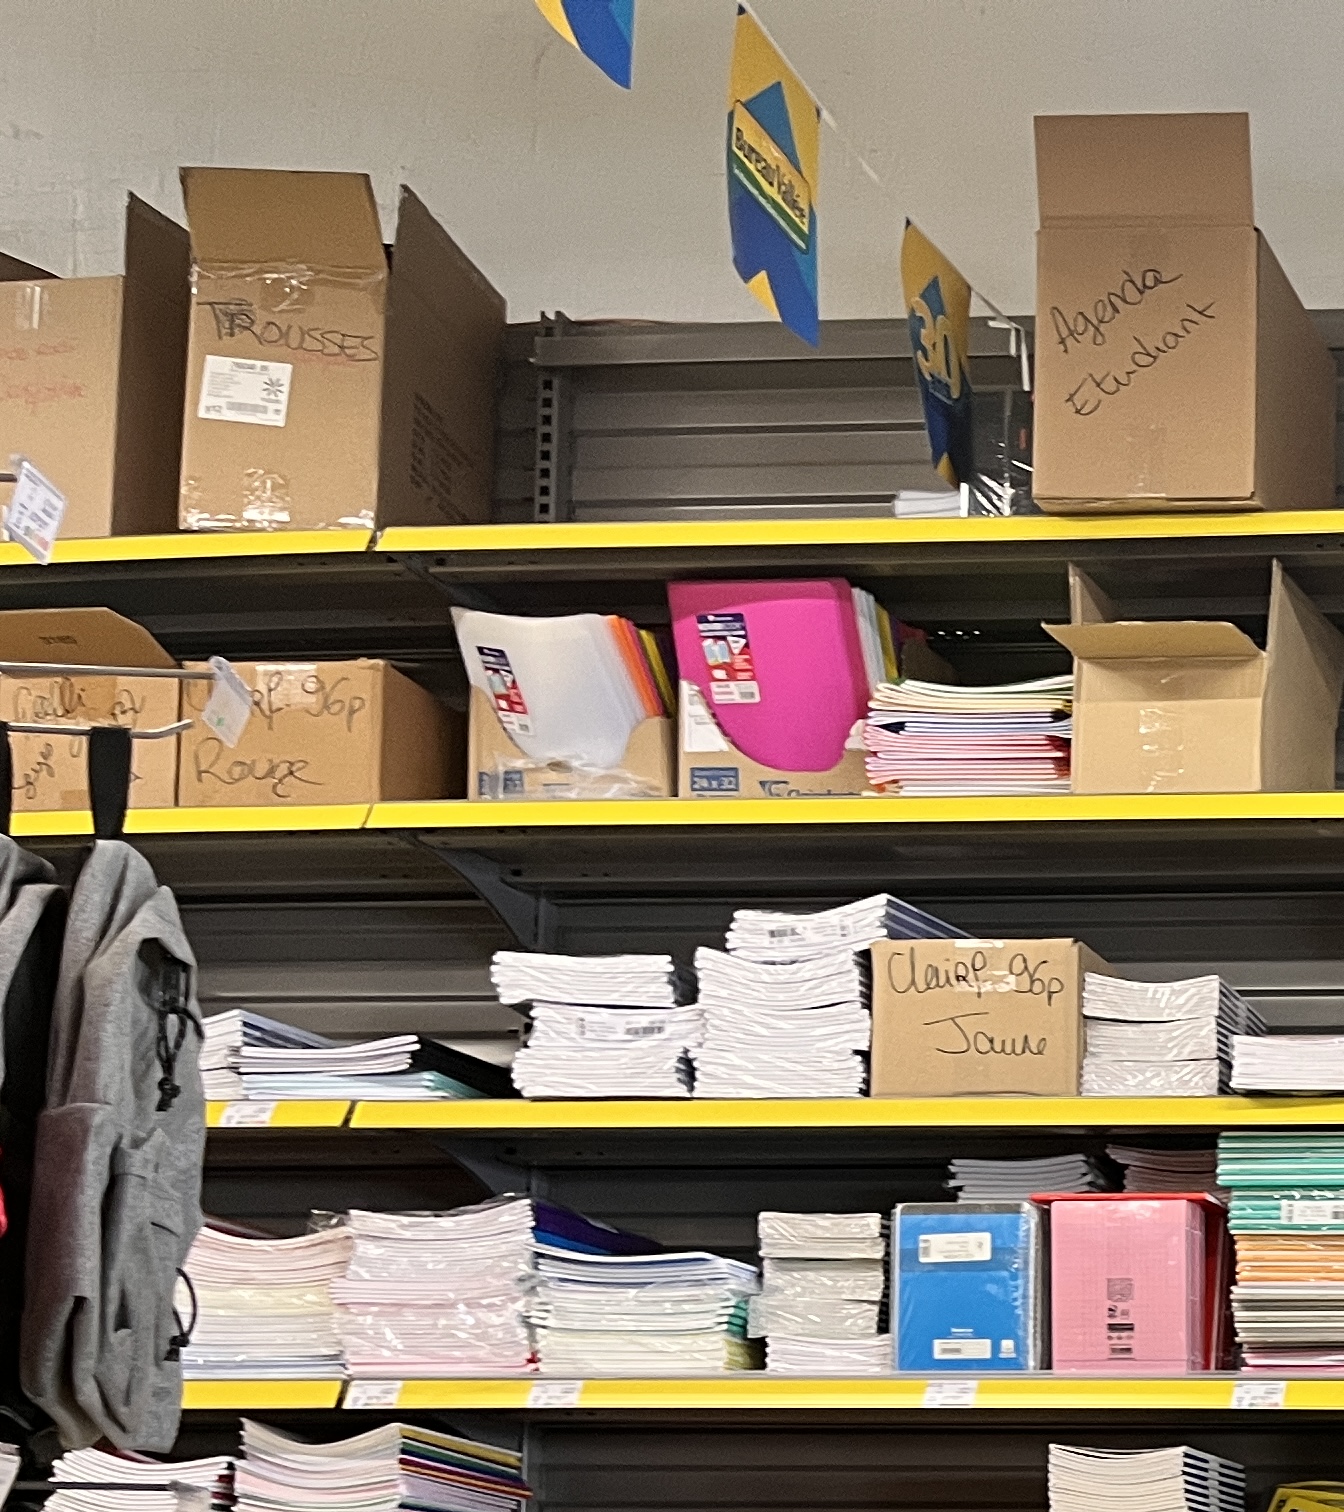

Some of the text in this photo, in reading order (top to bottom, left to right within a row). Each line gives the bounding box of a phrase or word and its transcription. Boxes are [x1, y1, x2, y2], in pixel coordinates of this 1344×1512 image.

[196, 298, 379, 362] TROUSSES
[1051, 267, 1183, 354] Agenda
[1065, 300, 1218, 417] Etudiant
[195, 736, 326, 798] Rouge
